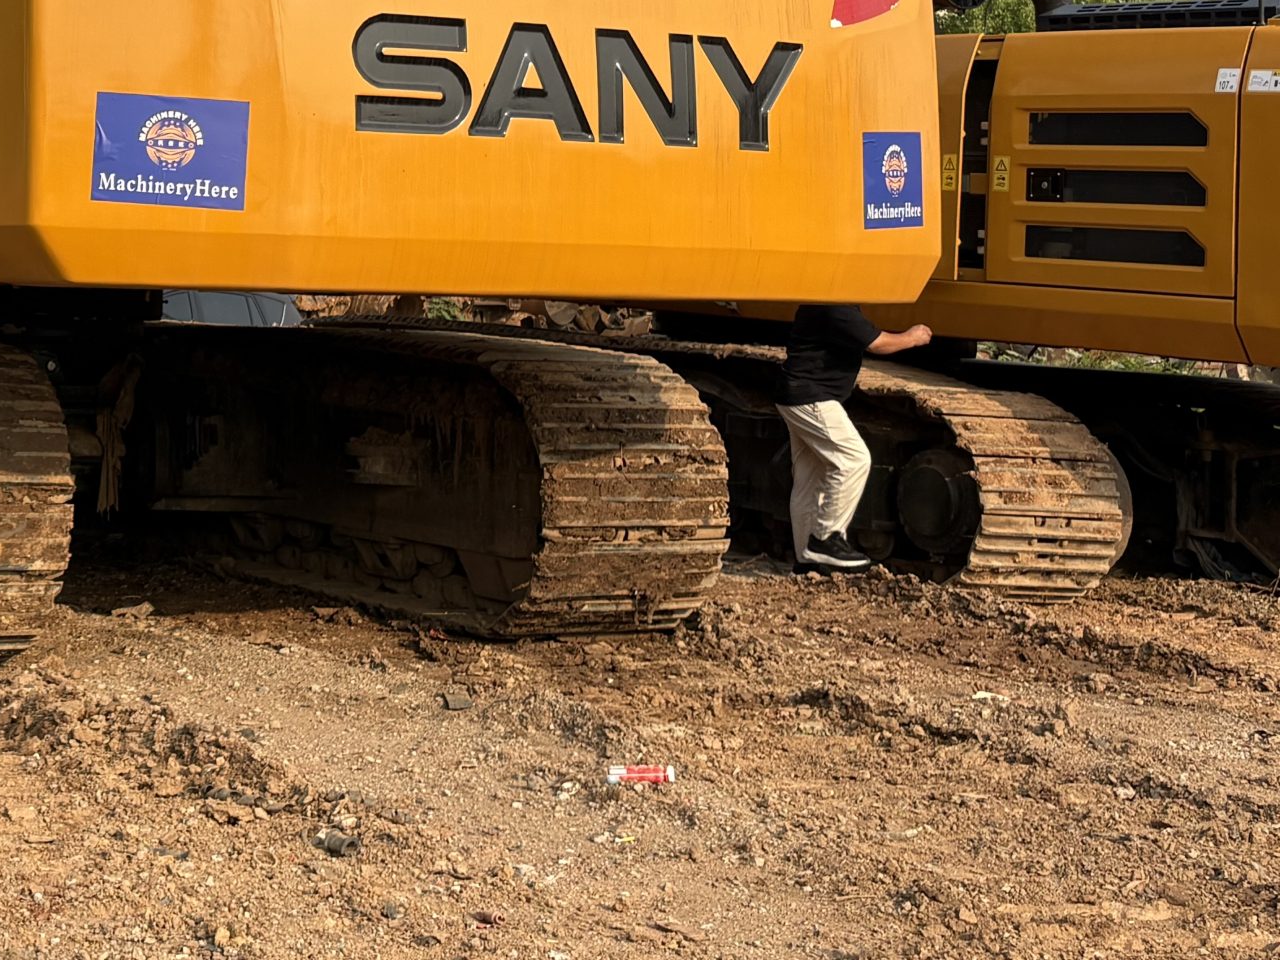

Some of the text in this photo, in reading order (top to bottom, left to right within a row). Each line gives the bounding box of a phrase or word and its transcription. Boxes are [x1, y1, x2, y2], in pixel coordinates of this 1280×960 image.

[352, 13, 803, 152] SANY
[98, 172, 238, 201] MachineryHere
[867, 202, 922, 222] MachineryHere
